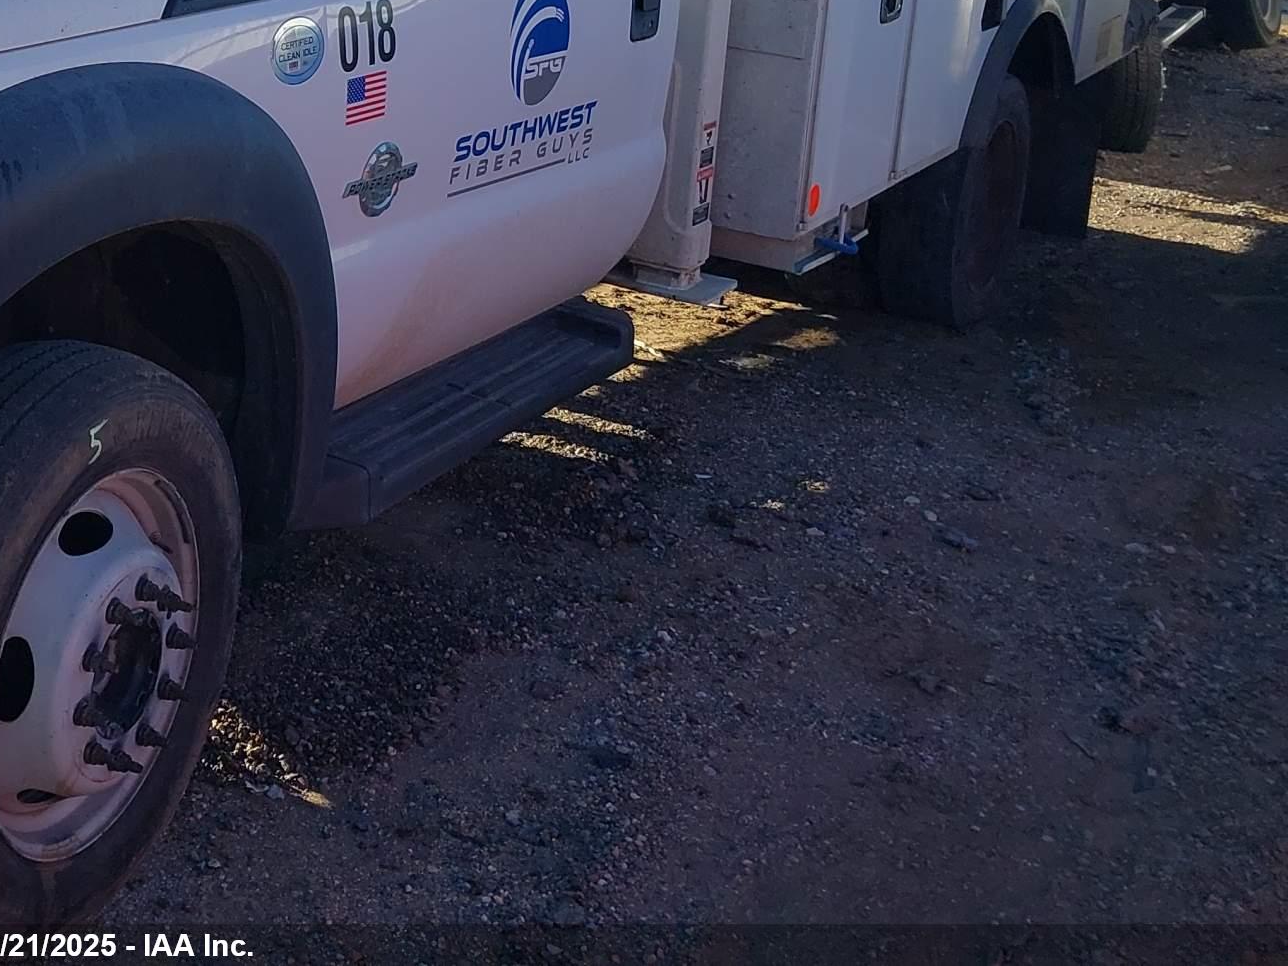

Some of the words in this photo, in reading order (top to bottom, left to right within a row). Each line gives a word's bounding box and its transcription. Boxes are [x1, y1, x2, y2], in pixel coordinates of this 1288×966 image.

[279, 51, 301, 63] CLEAN
[302, 45, 318, 57] IDLE
[281, 36, 314, 51] CERTIFIED
[453, 100, 599, 163] SOUTHWEST
[449, 148, 522, 185] FIBER
[536, 128, 594, 159] GUYS
[567, 147, 590, 165] LLC
[88, 417, 110, 466] 5
